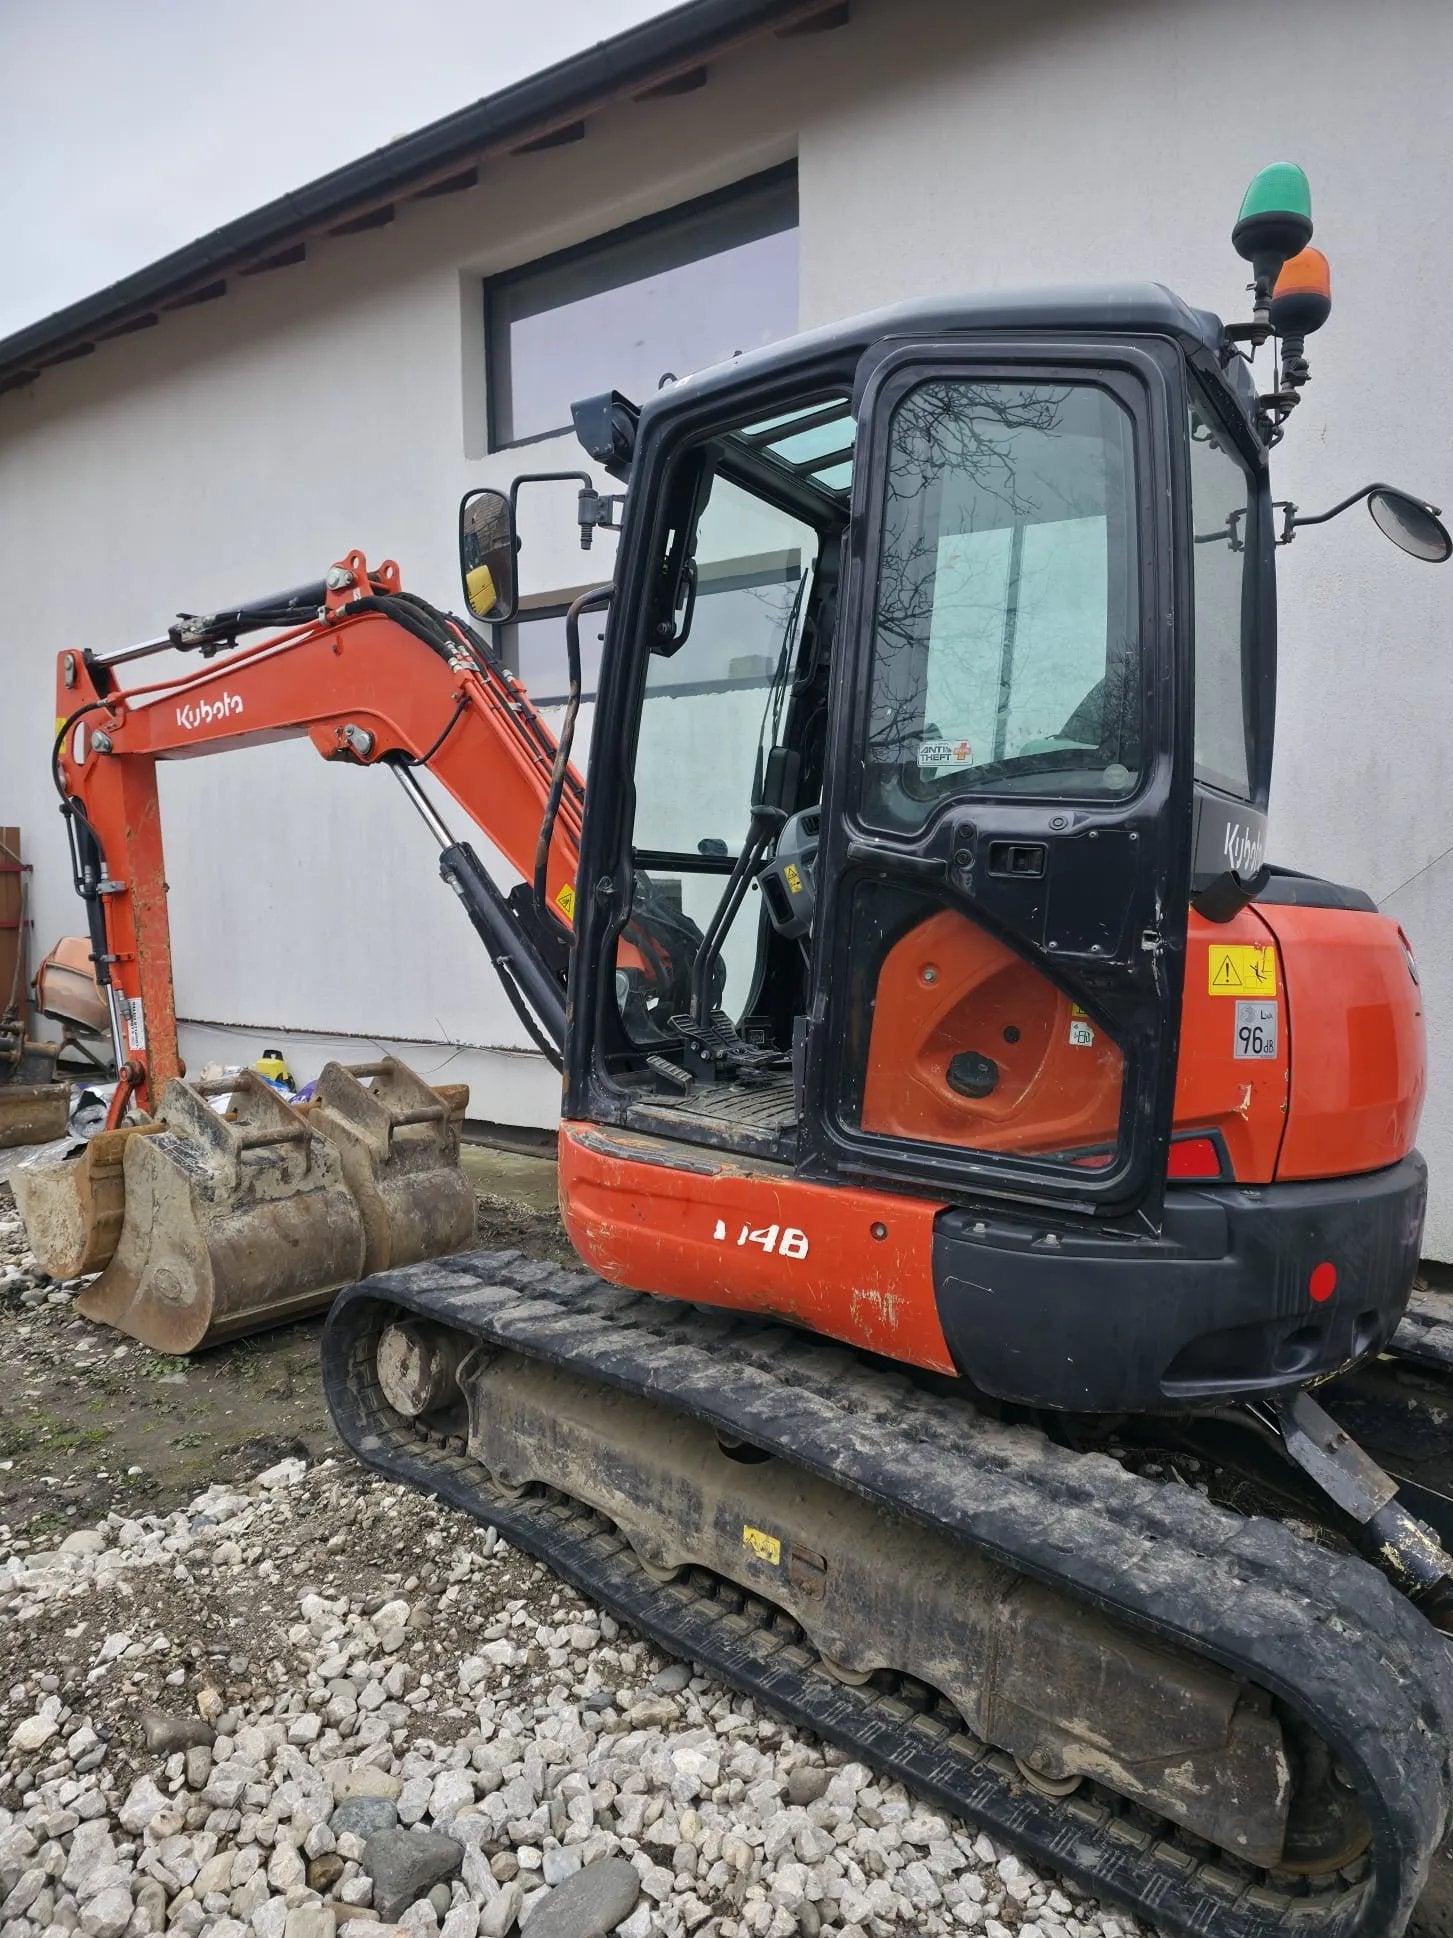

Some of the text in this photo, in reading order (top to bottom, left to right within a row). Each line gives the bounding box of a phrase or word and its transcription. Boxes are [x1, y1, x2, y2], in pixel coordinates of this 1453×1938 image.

[175, 691, 244, 730] Kubota
[919, 746, 945, 754] ANTI
[919, 753, 953, 761] THEFT
[1238, 1026, 1263, 1054] 96
